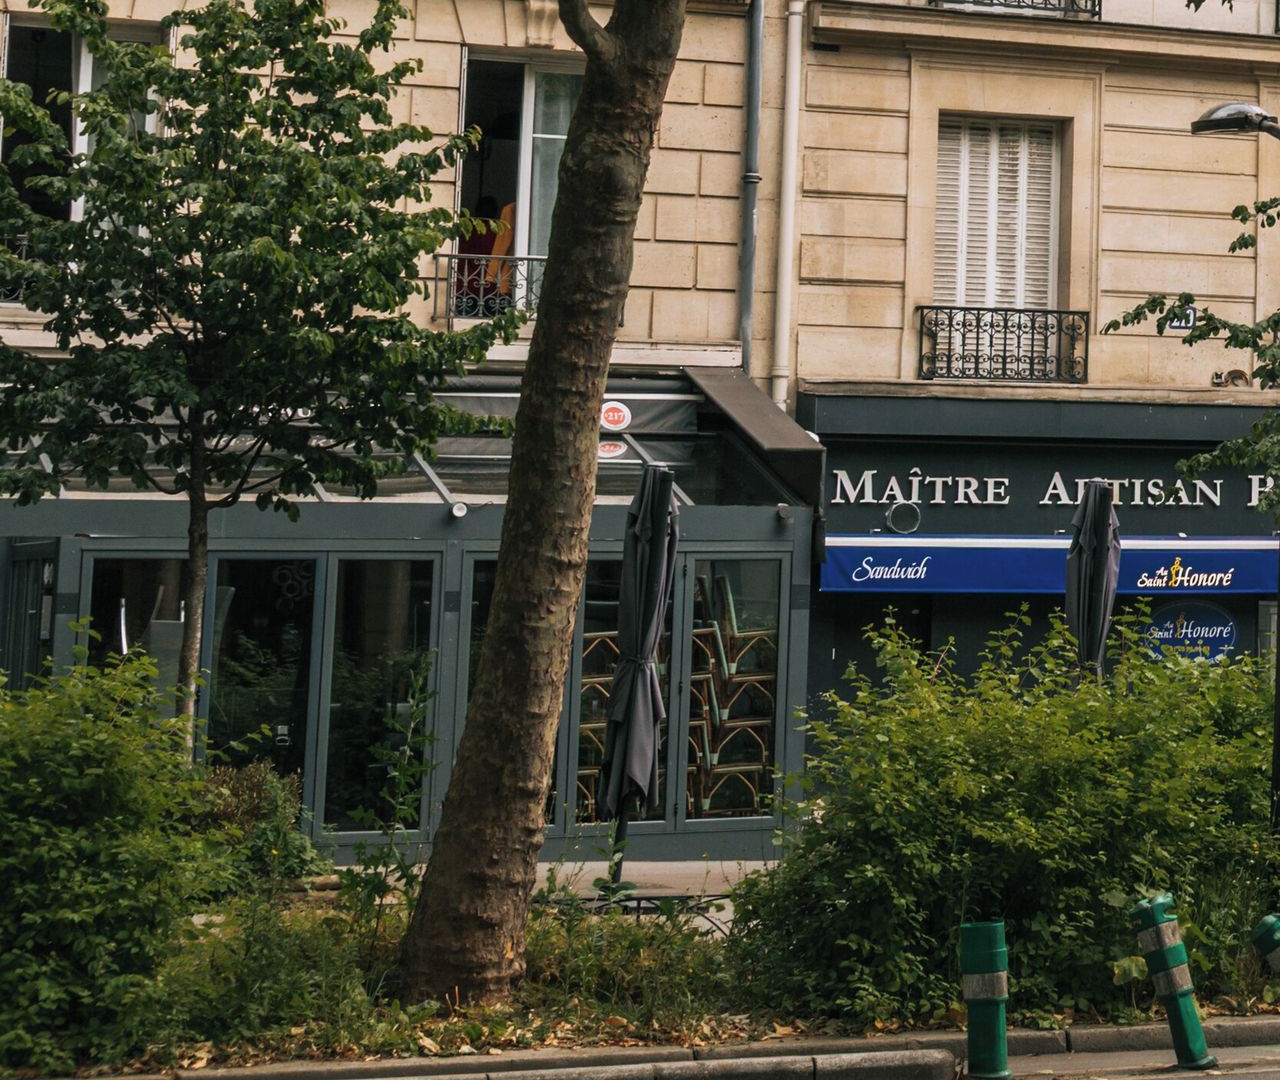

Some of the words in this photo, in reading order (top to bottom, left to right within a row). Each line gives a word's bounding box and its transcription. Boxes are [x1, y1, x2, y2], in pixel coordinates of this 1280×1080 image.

[831, 466, 1010, 505] MAÎTRE
[852, 556, 932, 583] Sandwich
[1137, 573, 1168, 588] Saint
[1175, 566, 1235, 588] Honoré
[1156, 566, 1168, 576] Au
[1180, 620, 1233, 638] Honoré
